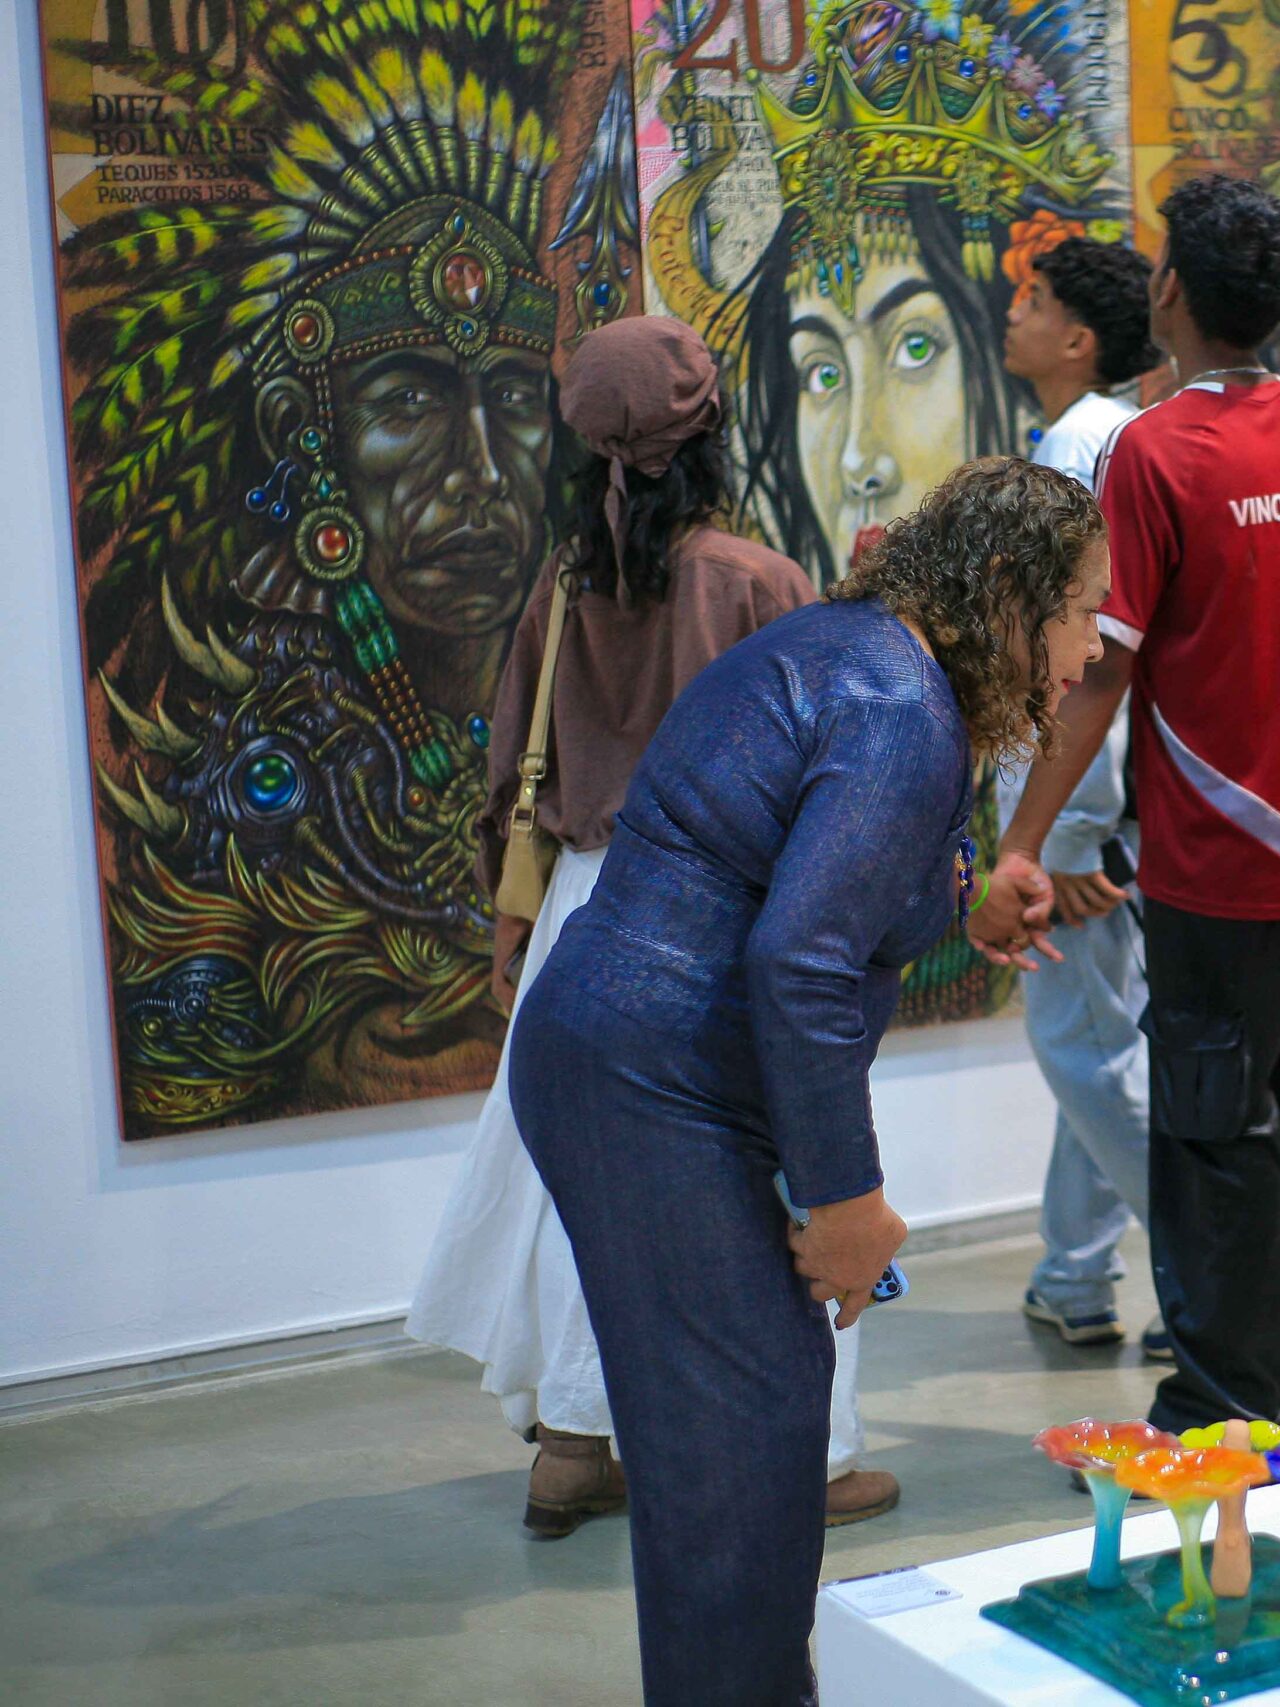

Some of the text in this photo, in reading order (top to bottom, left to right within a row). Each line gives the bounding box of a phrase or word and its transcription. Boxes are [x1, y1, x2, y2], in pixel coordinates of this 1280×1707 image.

[89, 93, 169, 125] DIEZ
[92, 124, 270, 157] BOLIVARES
[95, 164, 179, 183] TEQUES
[96, 184, 203, 204] PARACOTOS
